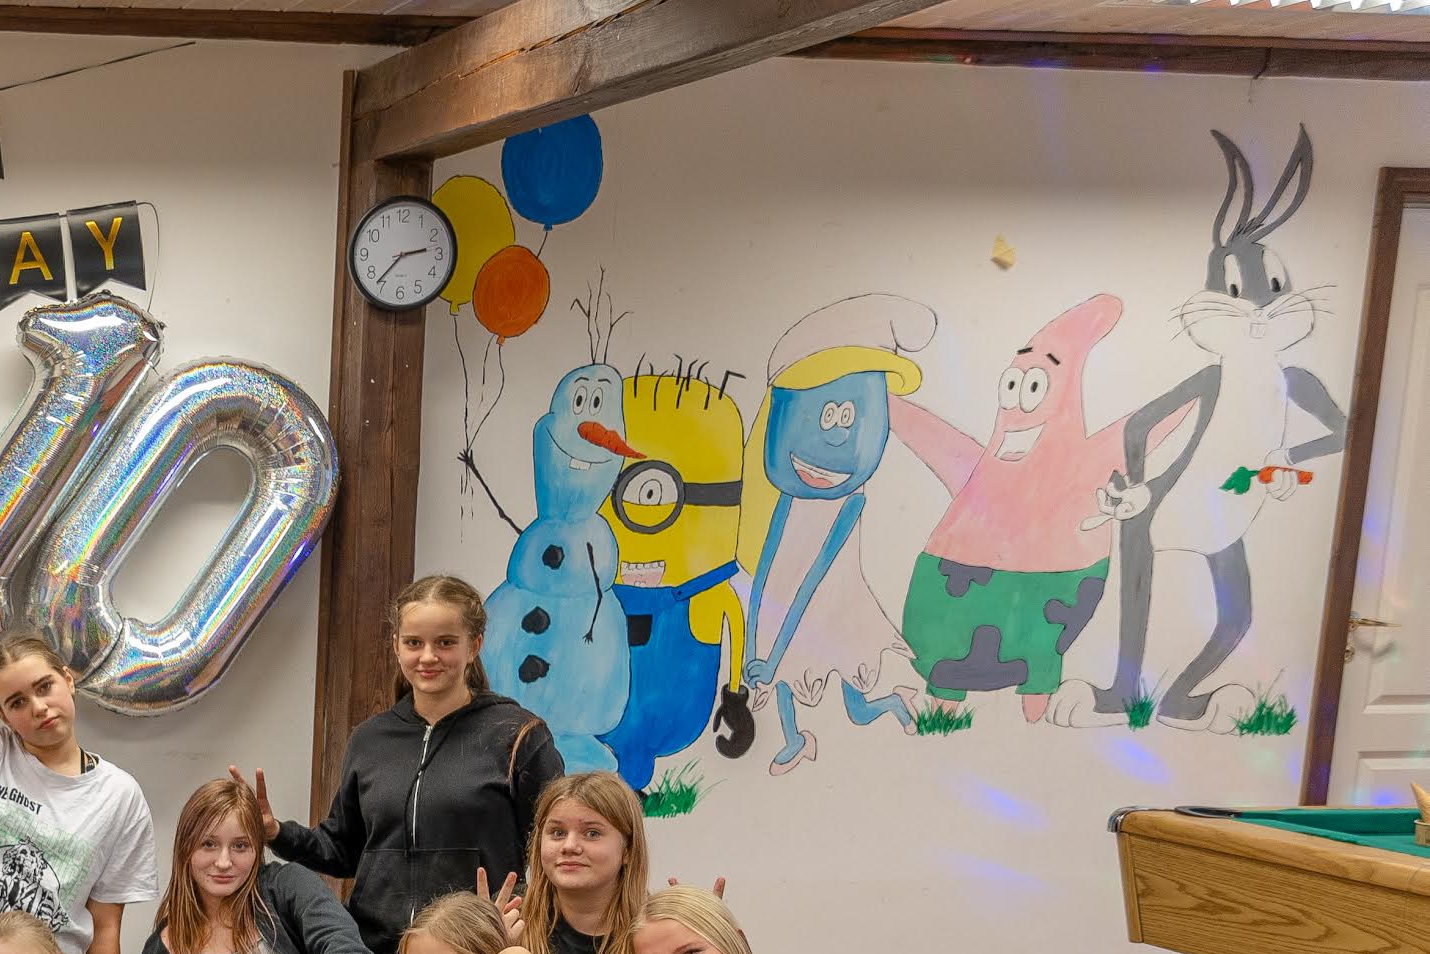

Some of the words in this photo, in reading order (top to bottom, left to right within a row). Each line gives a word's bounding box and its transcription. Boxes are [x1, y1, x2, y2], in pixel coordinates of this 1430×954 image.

[380, 215, 390, 229] 11
[397, 209, 410, 223] 12
[418, 214, 424, 229] 1
[367, 229, 380, 243] 10
[430, 228, 438, 242] 2
[360, 248, 368, 261] 9
[434, 247, 443, 261] 3
[367, 265, 375, 279] 8
[427, 266, 436, 278] 4
[395, 286, 405, 300] 6
[414, 280, 422, 294] 5
[9, 788, 42, 815] GHOST
